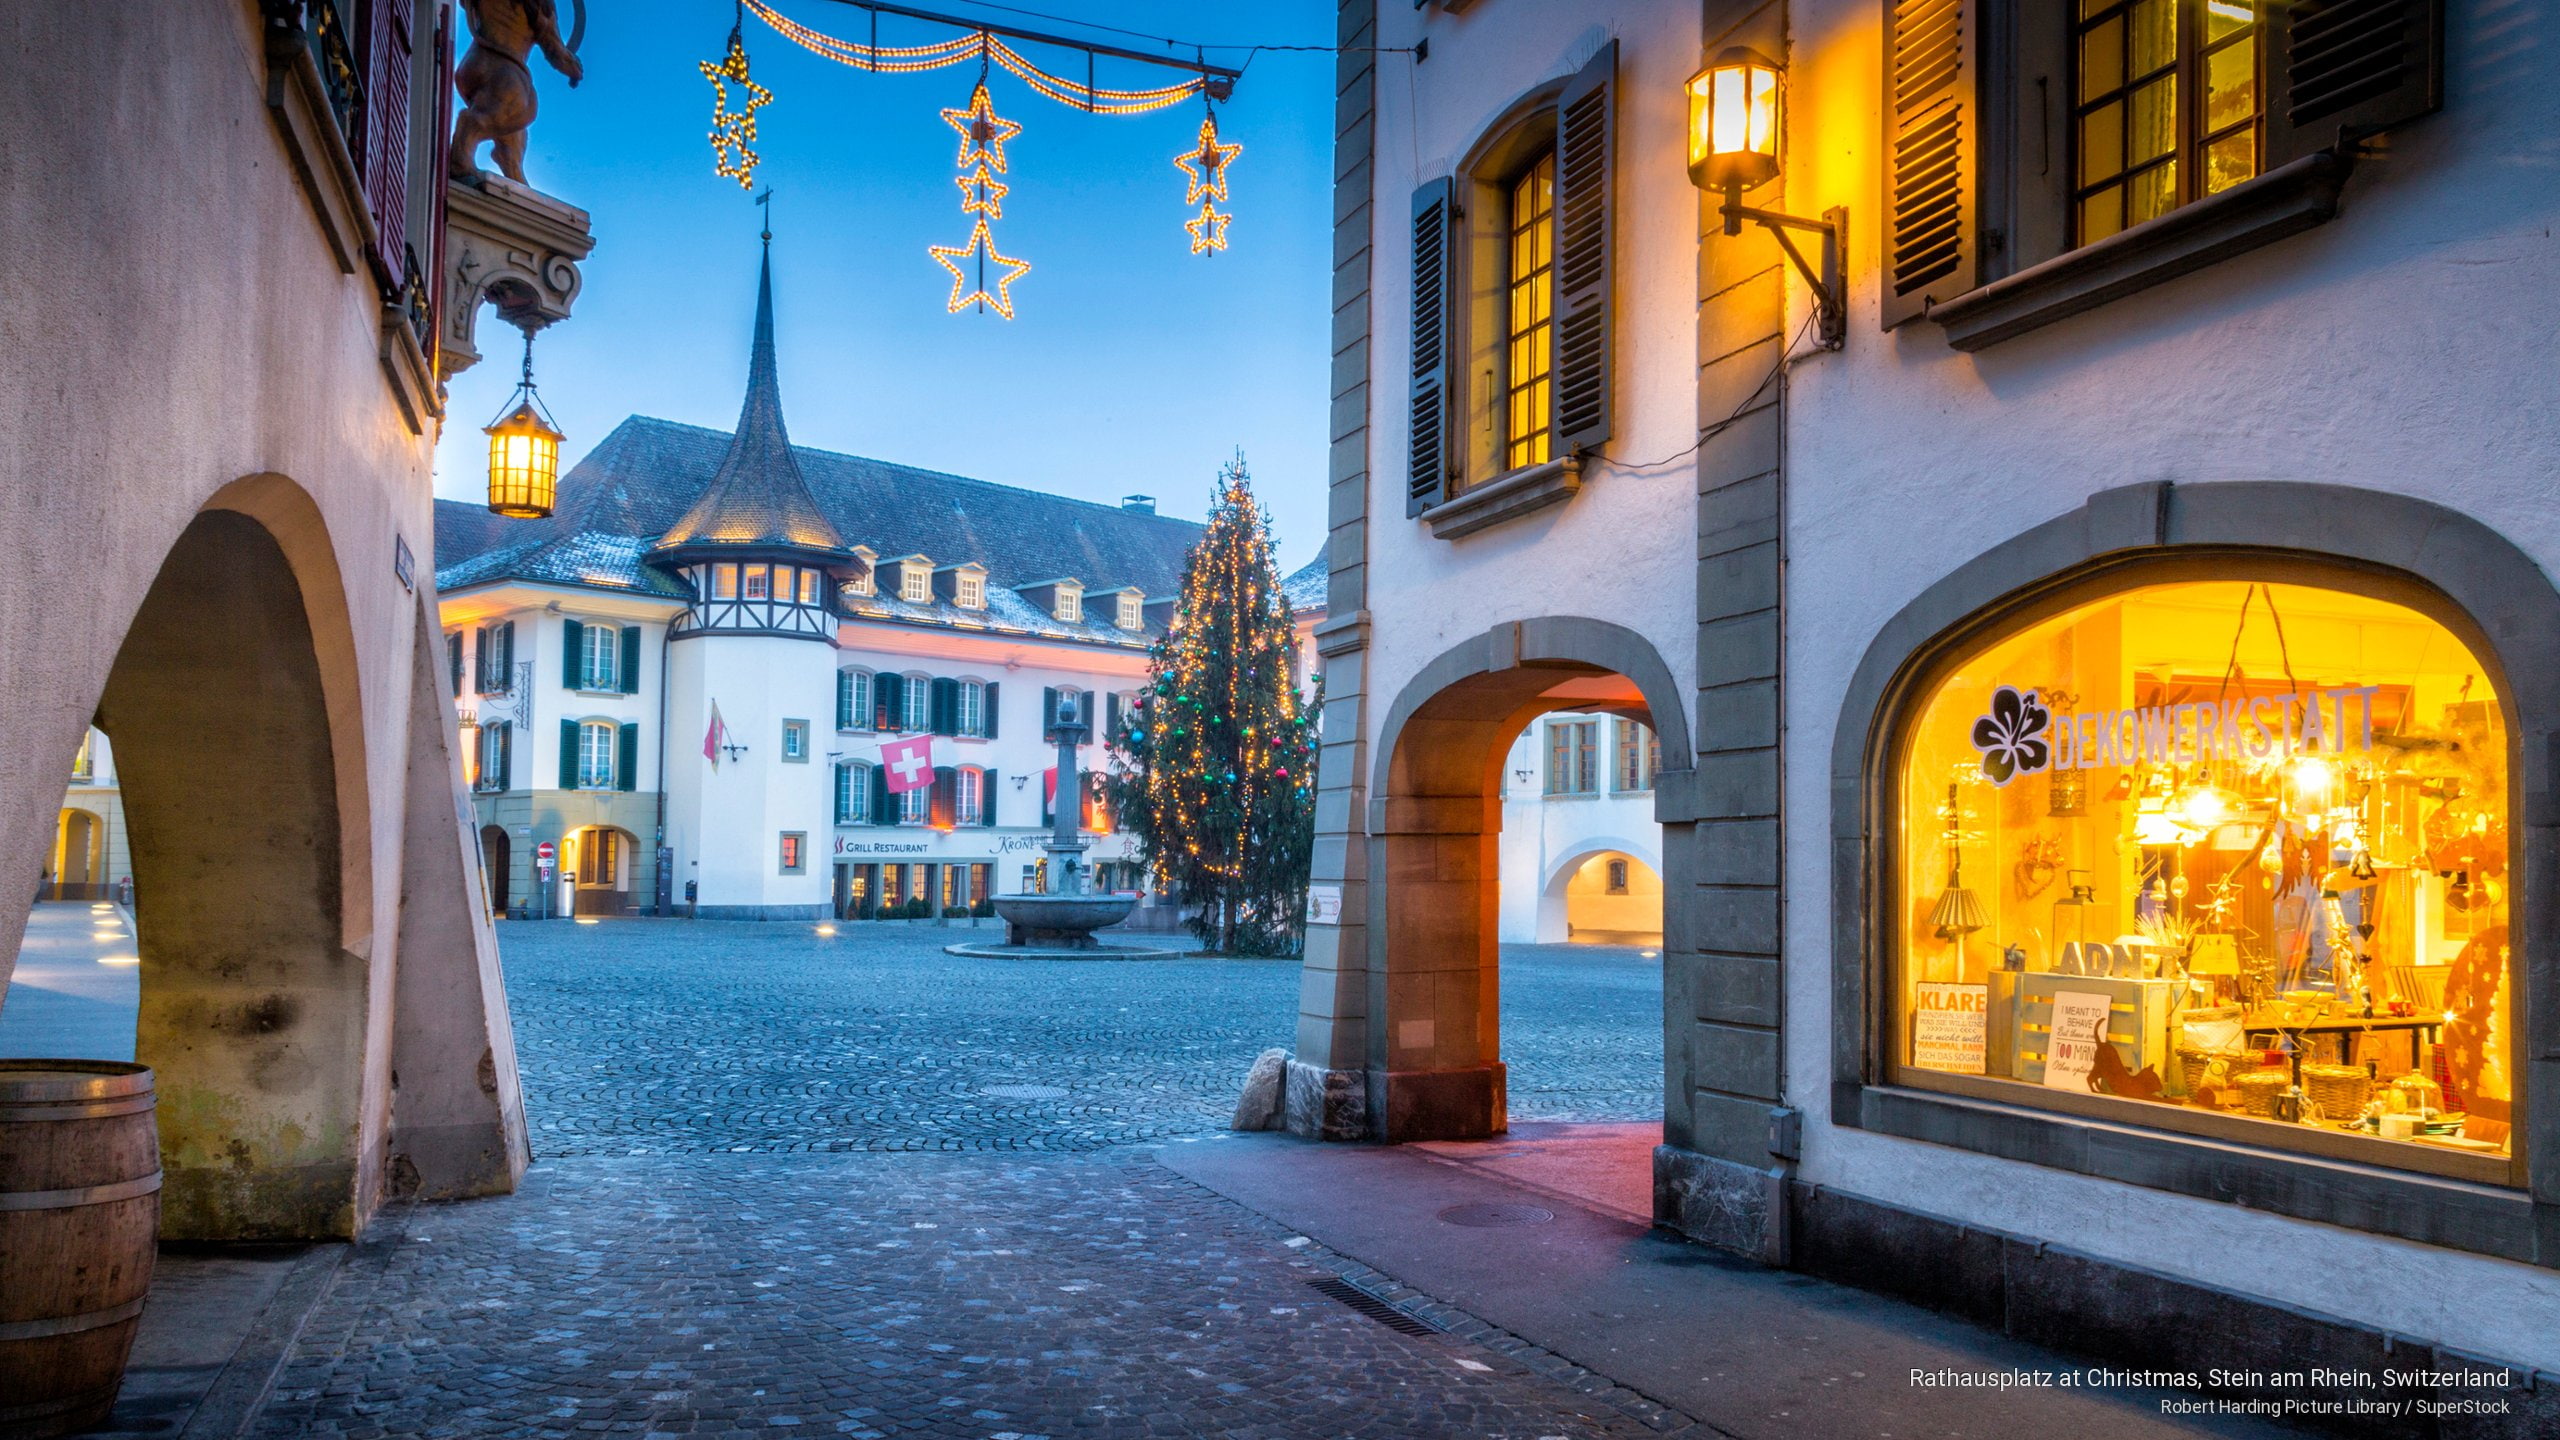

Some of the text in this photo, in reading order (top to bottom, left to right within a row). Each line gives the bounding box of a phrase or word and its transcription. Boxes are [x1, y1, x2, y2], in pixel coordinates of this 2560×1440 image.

[2055, 685, 2380, 770] DEKOWERKSTATT
[846, 842, 928, 853] GRILL RESTAURANT
[989, 836, 1035, 854] KRONE
[1920, 991, 1986, 1013] KLARE
[2065, 1006, 2090, 1016] MEANT
[2091, 1008, 2102, 1018] TO
[2067, 1017, 2094, 1029] BEHAVE
[1918, 1051, 1981, 1062] SICH DAS SOGAR
[2056, 1042, 2096, 1062] TOO MAN
